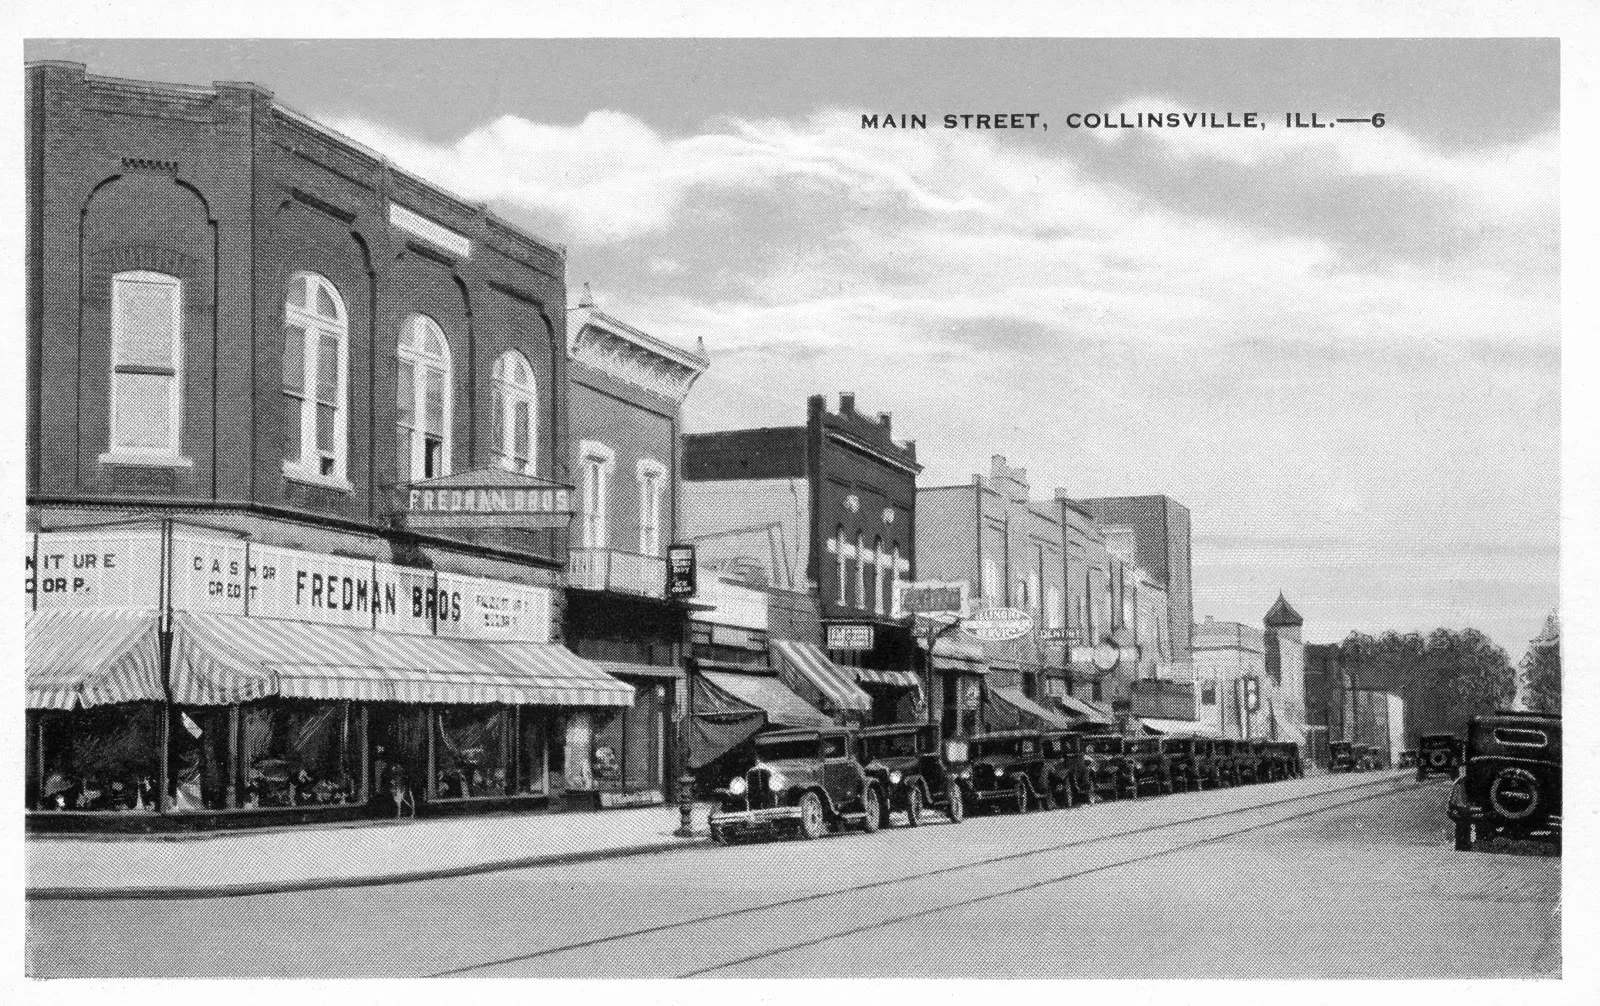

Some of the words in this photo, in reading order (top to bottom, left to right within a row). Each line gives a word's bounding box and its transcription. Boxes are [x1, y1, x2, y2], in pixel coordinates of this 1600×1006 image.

[409, 488, 507, 511] FREDMAN
[209, 581, 258, 600] CREDT
[296, 571, 396, 615] FREDMAN
[412, 585, 461, 622] BROS
